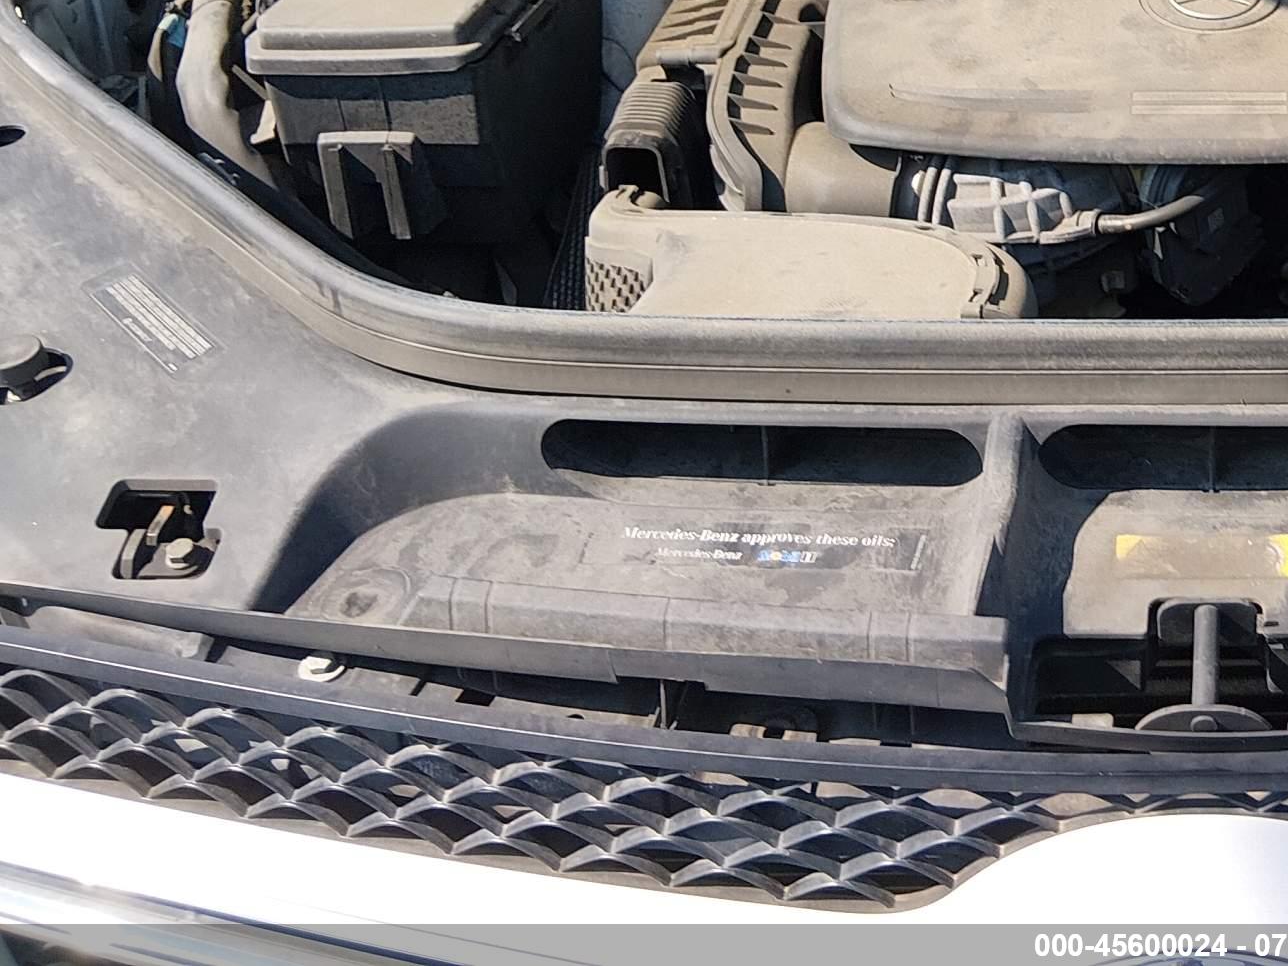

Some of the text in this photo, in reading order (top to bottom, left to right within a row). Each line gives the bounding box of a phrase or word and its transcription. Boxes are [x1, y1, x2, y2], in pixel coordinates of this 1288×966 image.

[623, 526, 896, 548] Mercedes-Benz approves these oils:
